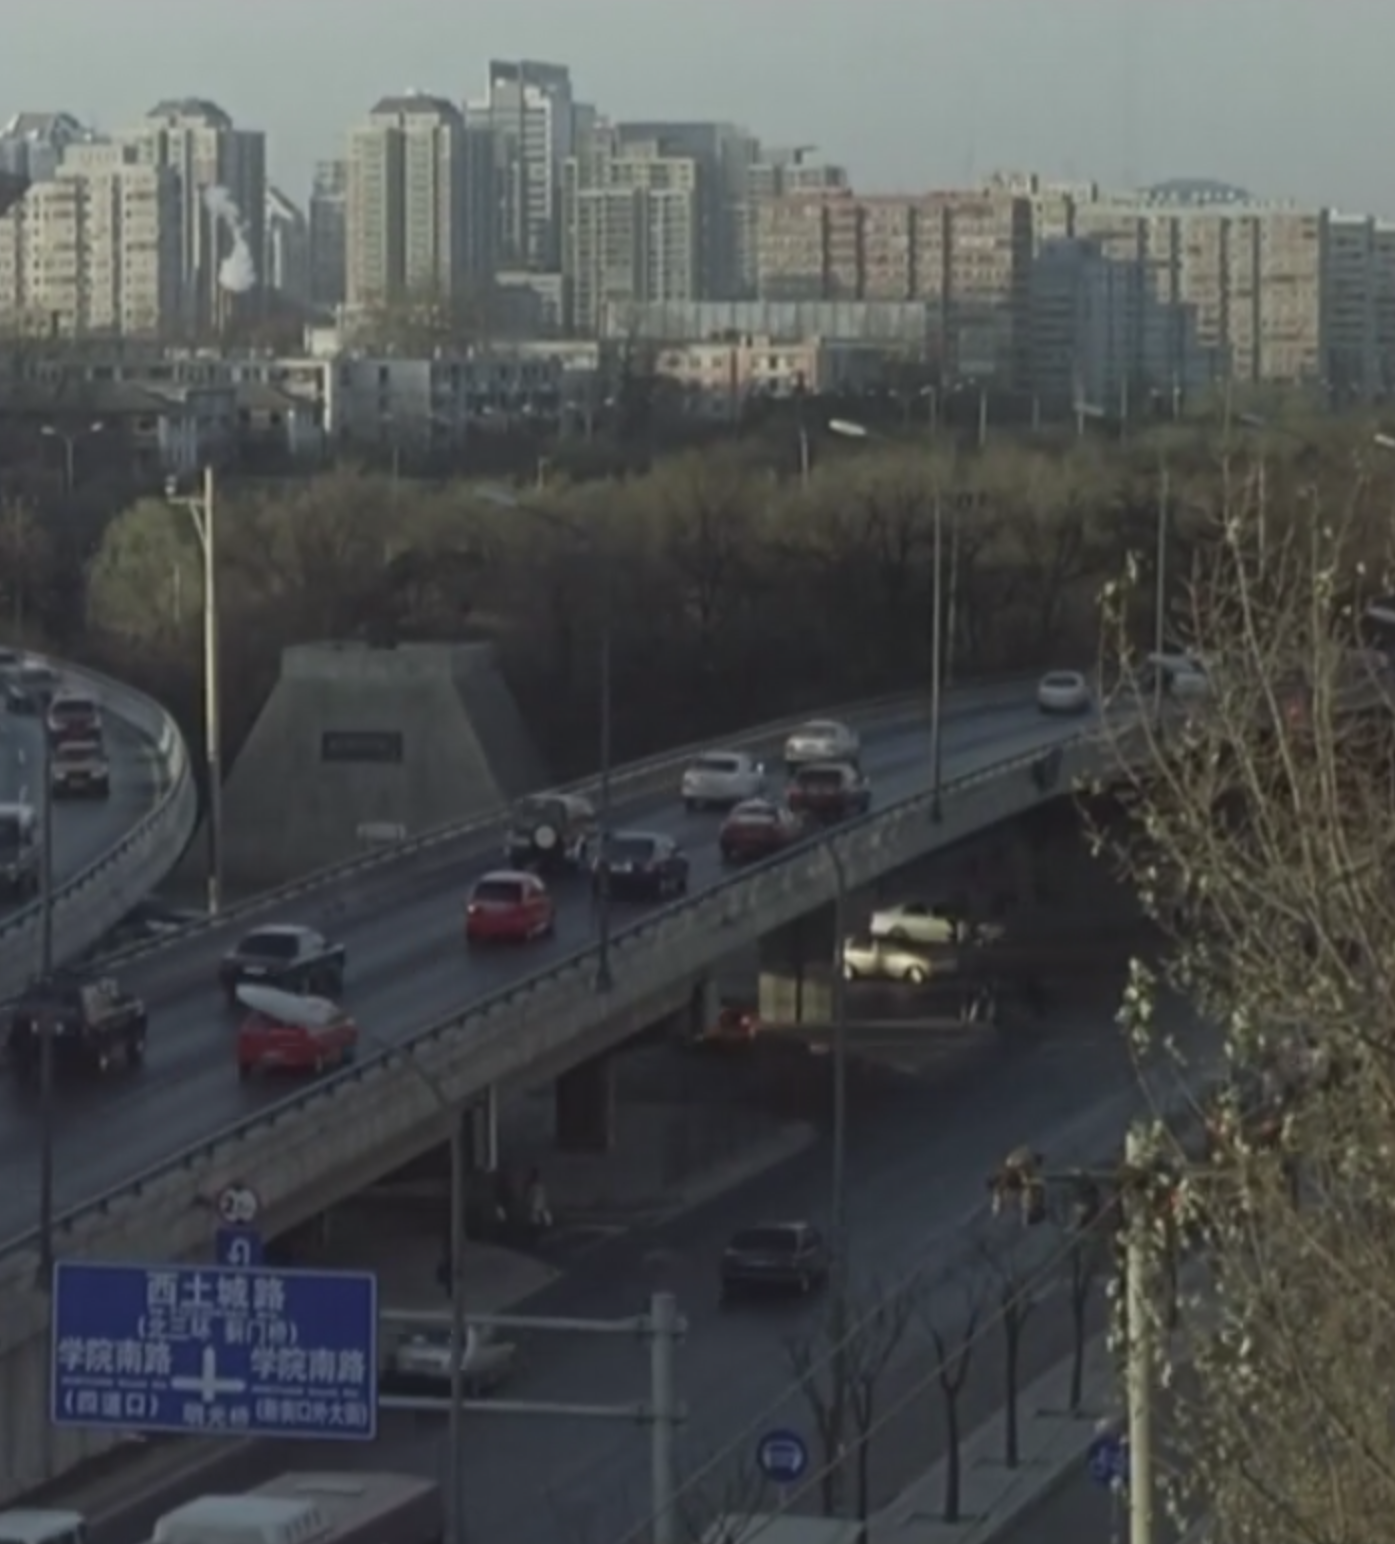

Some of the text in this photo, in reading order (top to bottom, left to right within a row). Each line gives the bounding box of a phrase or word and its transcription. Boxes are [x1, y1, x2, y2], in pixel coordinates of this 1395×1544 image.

[147, 1272, 285, 1310] 西土城路
[58, 1337, 172, 1375] 学院南路
[251, 1347, 366, 1384] 学院南路
